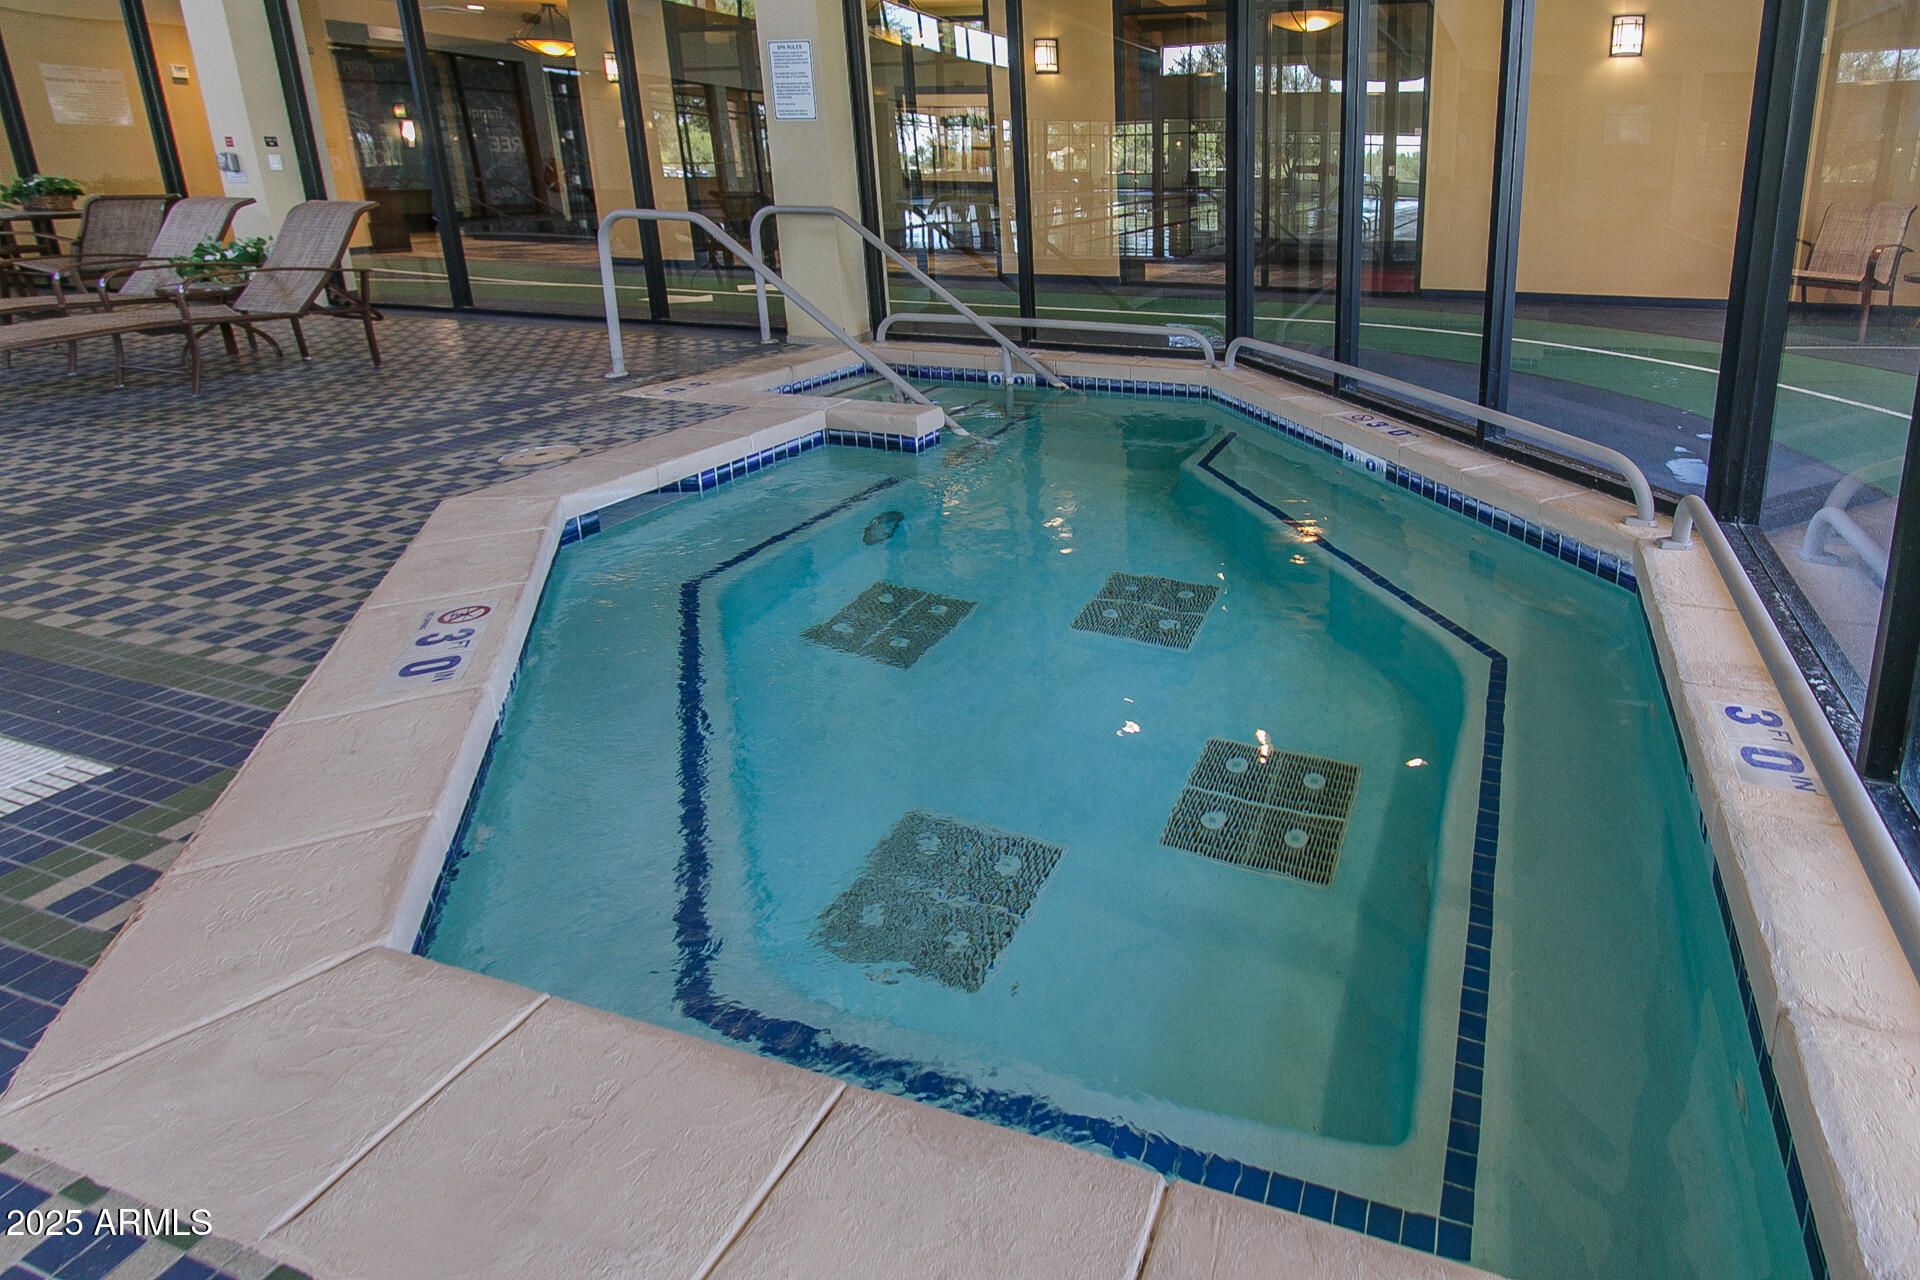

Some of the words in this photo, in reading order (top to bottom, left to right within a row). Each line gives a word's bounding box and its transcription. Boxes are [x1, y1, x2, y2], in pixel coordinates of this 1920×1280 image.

[415, 628, 476, 646] 3
[398, 655, 462, 678] 0
[431, 669, 457, 683] IN
[1724, 706, 1783, 728] 3
[1768, 729, 1794, 745] FT
[1740, 746, 1805, 774] 0
[1789, 775, 1817, 792] IN
